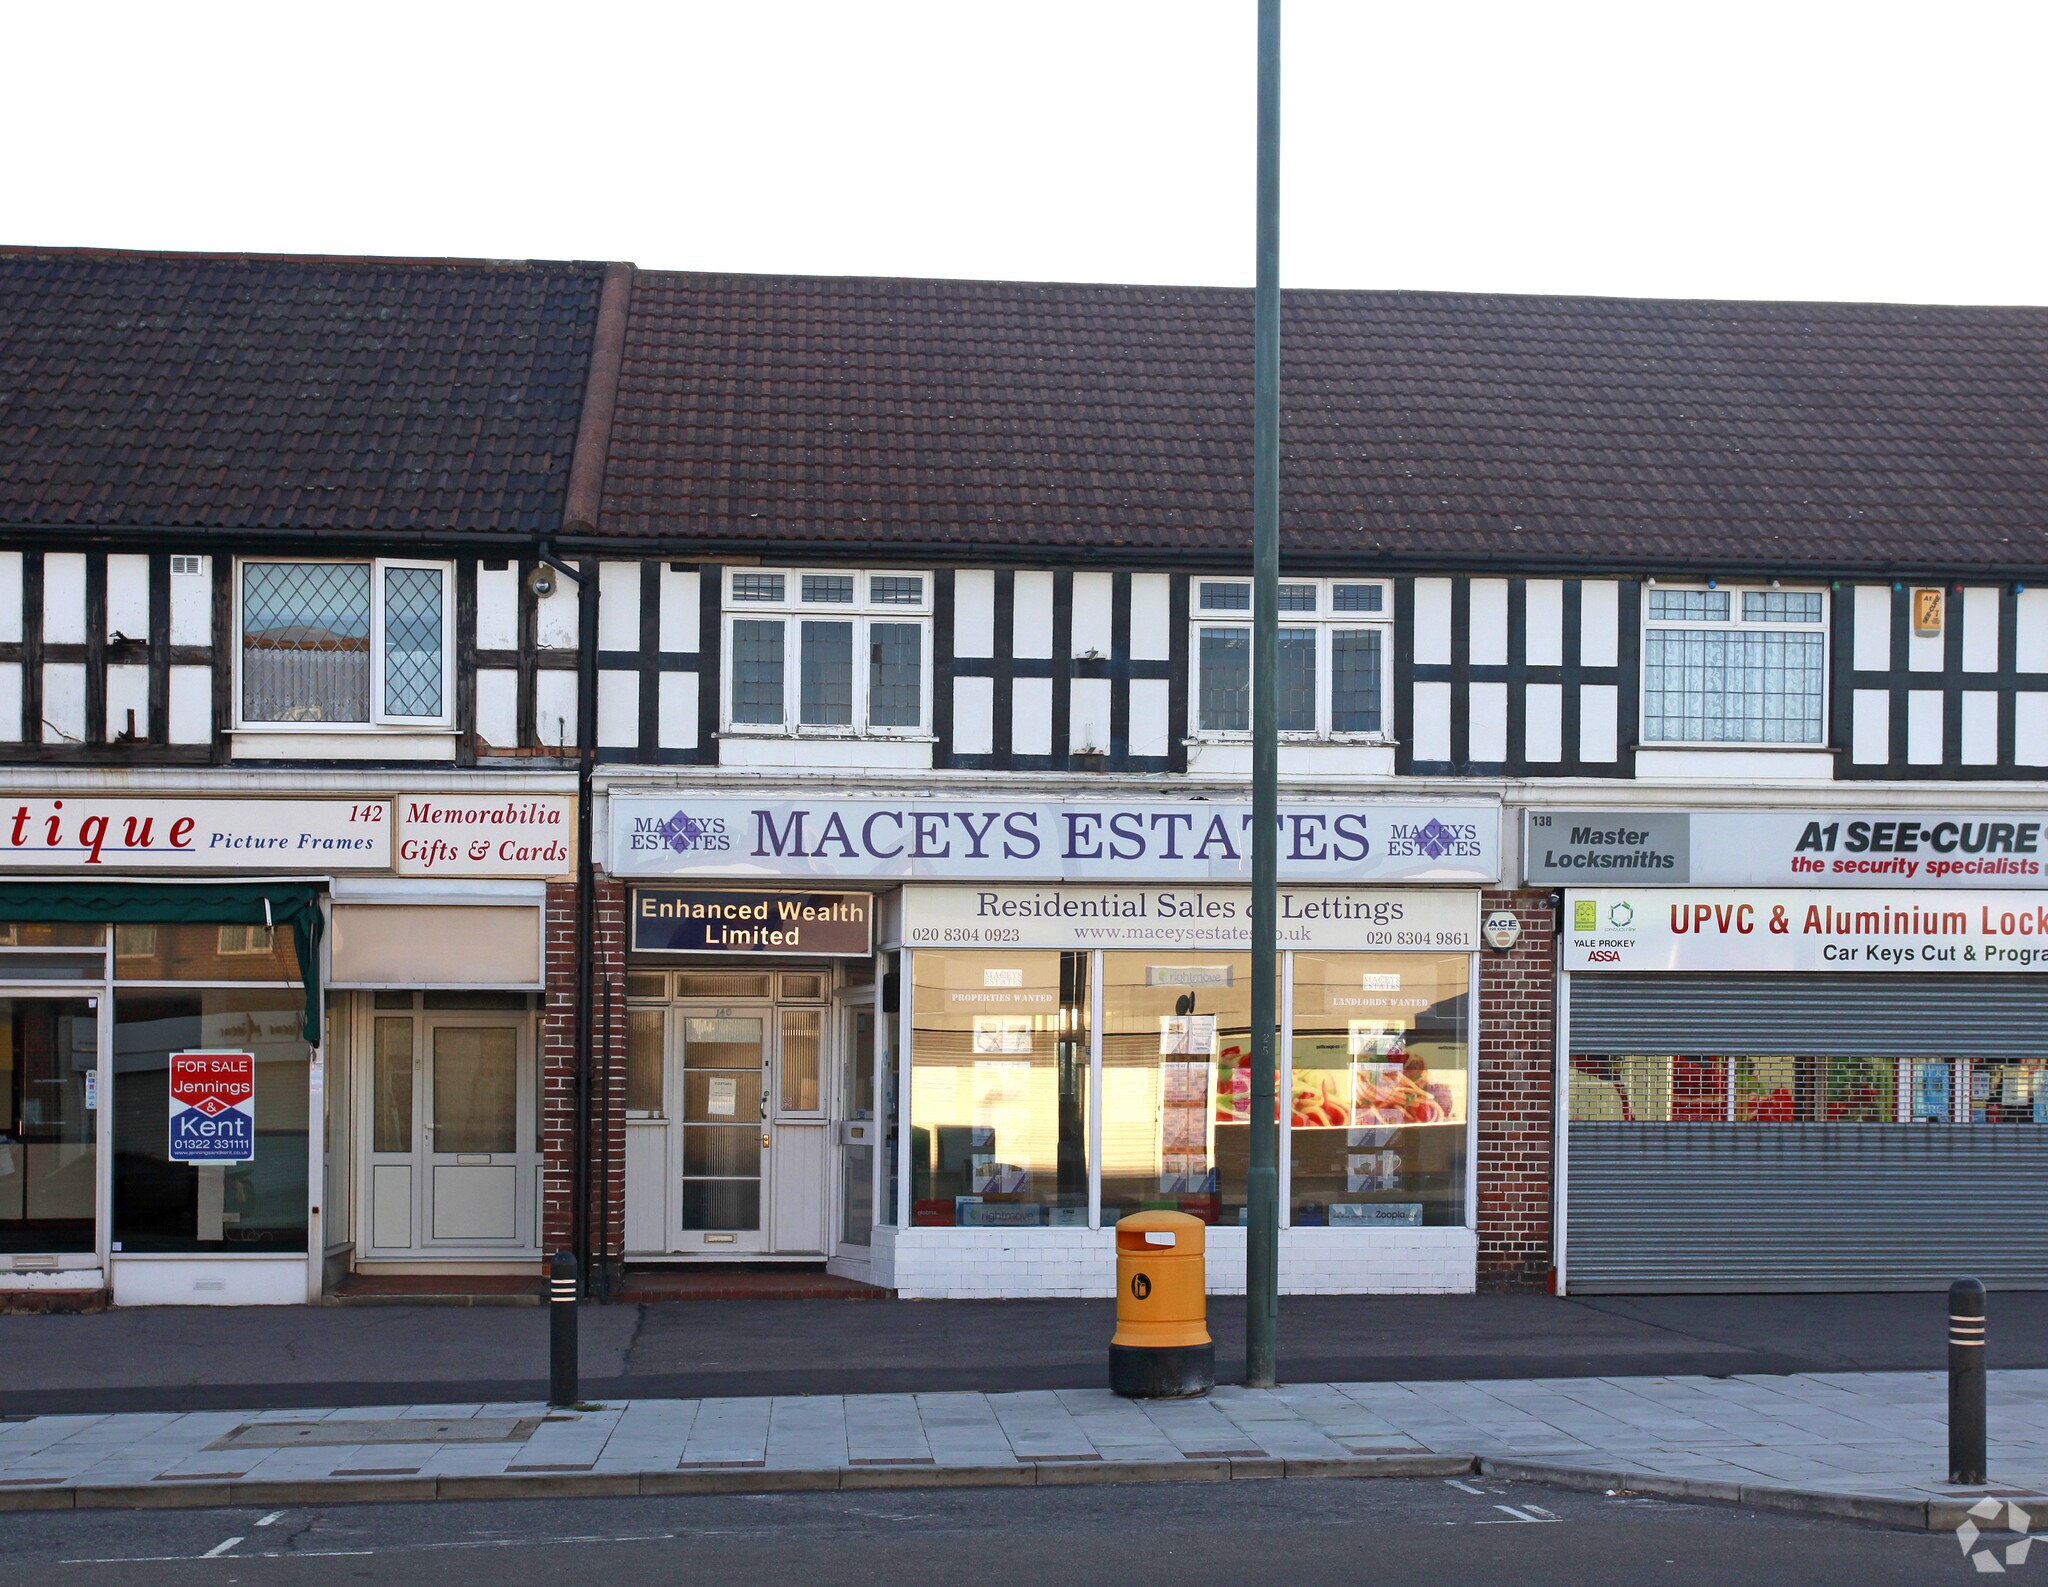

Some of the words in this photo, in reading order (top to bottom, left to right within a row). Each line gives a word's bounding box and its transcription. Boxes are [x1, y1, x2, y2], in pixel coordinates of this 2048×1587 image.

[348, 805, 383, 822] 142
[406, 803, 561, 824] Memorabilia
[1532, 815, 1552, 827] 138
[634, 817, 726, 833] MACEYS
[1391, 824, 1477, 839] MACEYS
[209, 832, 289, 849] Picture
[297, 833, 374, 850] Frames
[750, 809, 1041, 860] MACEYS
[1570, 827, 1650, 845] Master
[1794, 821, 1840, 852] A1
[630, 835, 730, 851] ESTATES
[1387, 841, 1481, 857] ESTATES
[400, 839, 459, 868] Gifts
[468, 840, 491, 861] &
[498, 840, 568, 862] Cards
[1544, 850, 1675, 868] Locksmiths
[1791, 856, 1826, 873] the
[1832, 857, 1920, 878] security
[1925, 858, 2040, 878] specialists
[641, 898, 768, 920] Enhanced
[778, 900, 864, 923] Wealth
[976, 892, 1148, 917] Residential
[1157, 893, 1236, 918] Sales
[1281, 894, 1404, 925] Lettings
[1669, 903, 1754, 934] UPVC
[1768, 904, 1790, 934] &
[1802, 904, 1968, 935] Aluminium
[705, 924, 800, 945] Limited
[912, 928, 939, 942] 020
[944, 928, 979, 942] 8304
[984, 929, 1020, 942] 0923
[1074, 926, 1312, 943] www.maceysestateo.uk
[1366, 931, 1392, 945] 020
[1397, 932, 1431, 945] 8304
[1435, 932, 1469, 946] 9861
[1574, 939, 1596, 947] YALE
[1598, 939, 1636, 947] PROKEY
[1588, 950, 1621, 962] ASSA
[1822, 944, 1859, 961] Car
[1866, 944, 1915, 965] Keys
[1921, 945, 1956, 961] Cut
[1963, 945, 1977, 961] &
[1169, 972, 1222, 983] rightmove
[952, 993, 1011, 1002] PROPERTIES
[1013, 994, 1053, 1002] WANTED
[1333, 997, 1388, 1006] LANDLORDS
[1390, 998, 1428, 1007] WANTED
[716, 1008, 732, 1017] 140
[177, 1060, 207, 1073] FOR
[211, 1060, 248, 1073] SALE
[173, 1080, 251, 1096] Jennings
[206, 1101, 217, 1113] &
[180, 1116, 245, 1137] Kent
[174, 1139, 211, 1149] 01322
[213, 1139, 249, 1149] 331111
